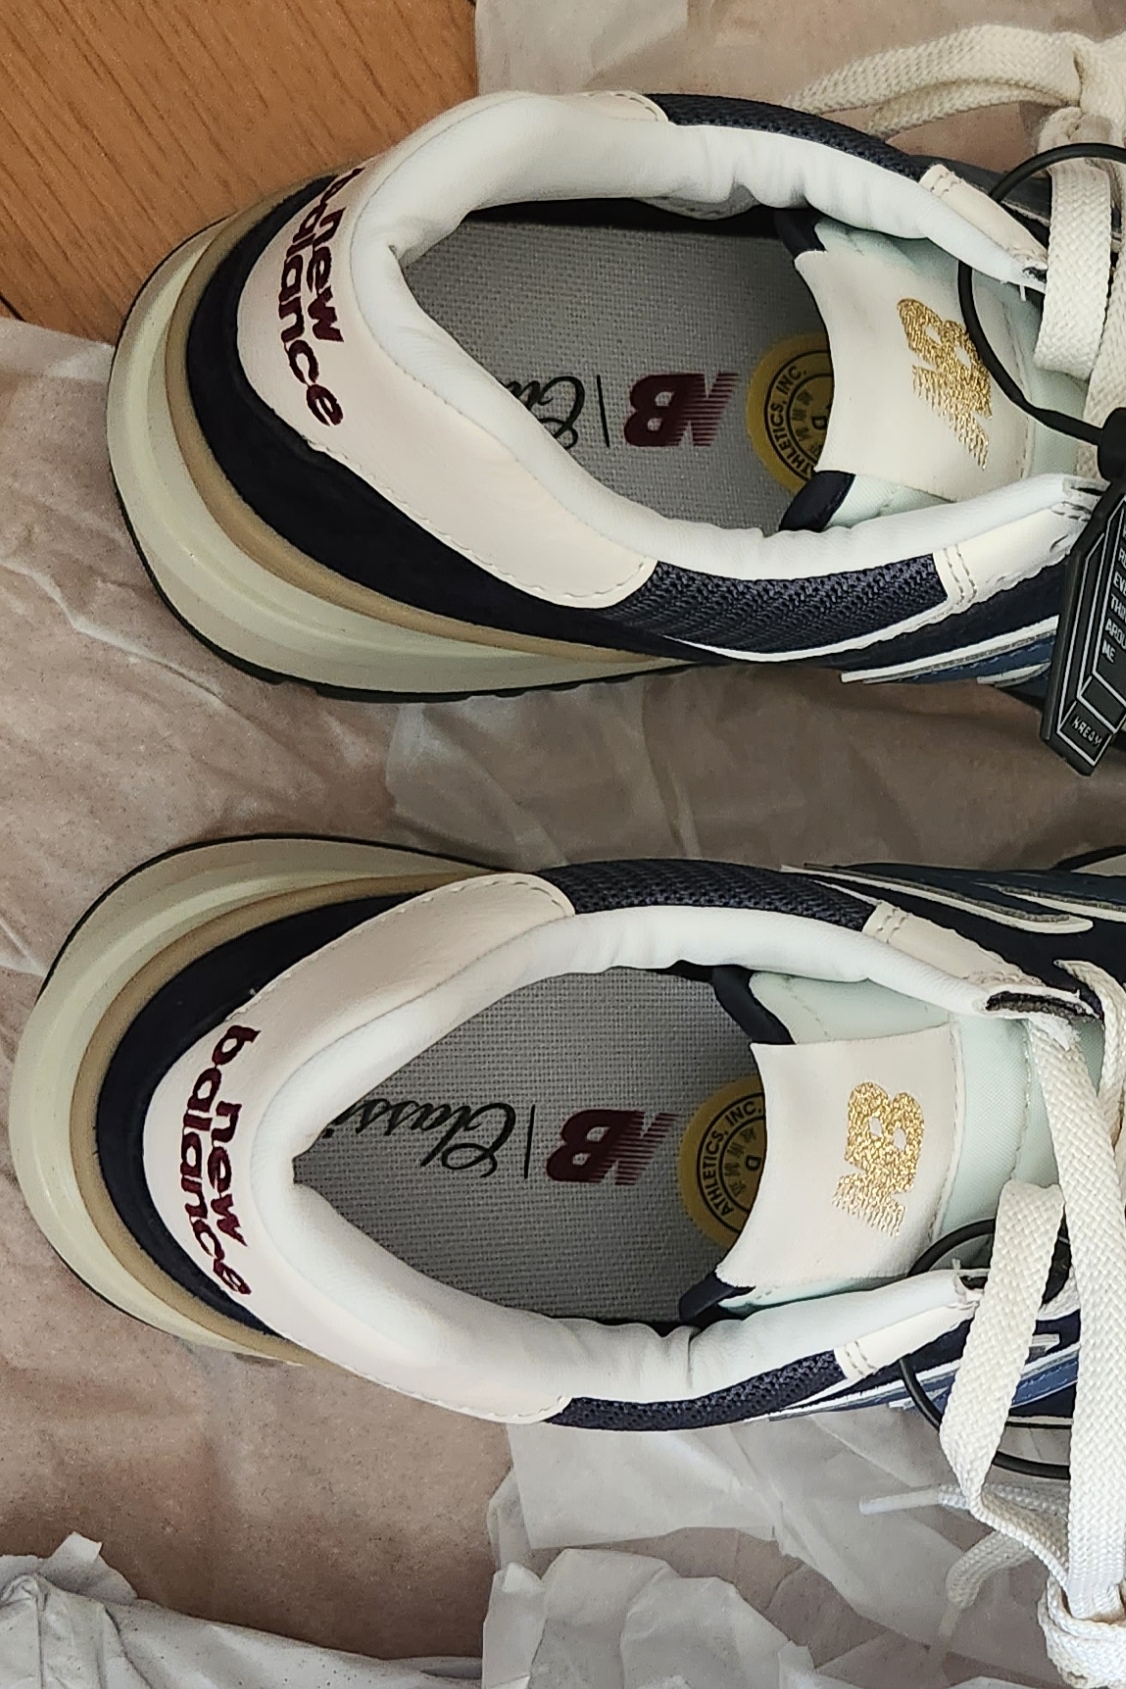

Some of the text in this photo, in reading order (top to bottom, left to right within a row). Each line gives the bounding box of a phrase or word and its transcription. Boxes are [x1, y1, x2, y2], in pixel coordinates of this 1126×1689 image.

[279, 168, 366, 427] balance
[307, 208, 346, 342] new
[623, 372, 738, 447] NB
[770, 401, 814, 475] THLETICS,
[776, 366, 807, 395] INC.
[897, 297, 992, 471] NB
[1101, 640, 1117, 664] ME
[180, 1025, 261, 1295] balance
[207, 1101, 248, 1247] new
[322, 1099, 516, 1178] Classi
[546, 1109, 679, 1186] NB
[703, 1130, 734, 1216] ATHLETICS,
[725, 1101, 762, 1126] INC.
[832, 1081, 924, 1236] NB
